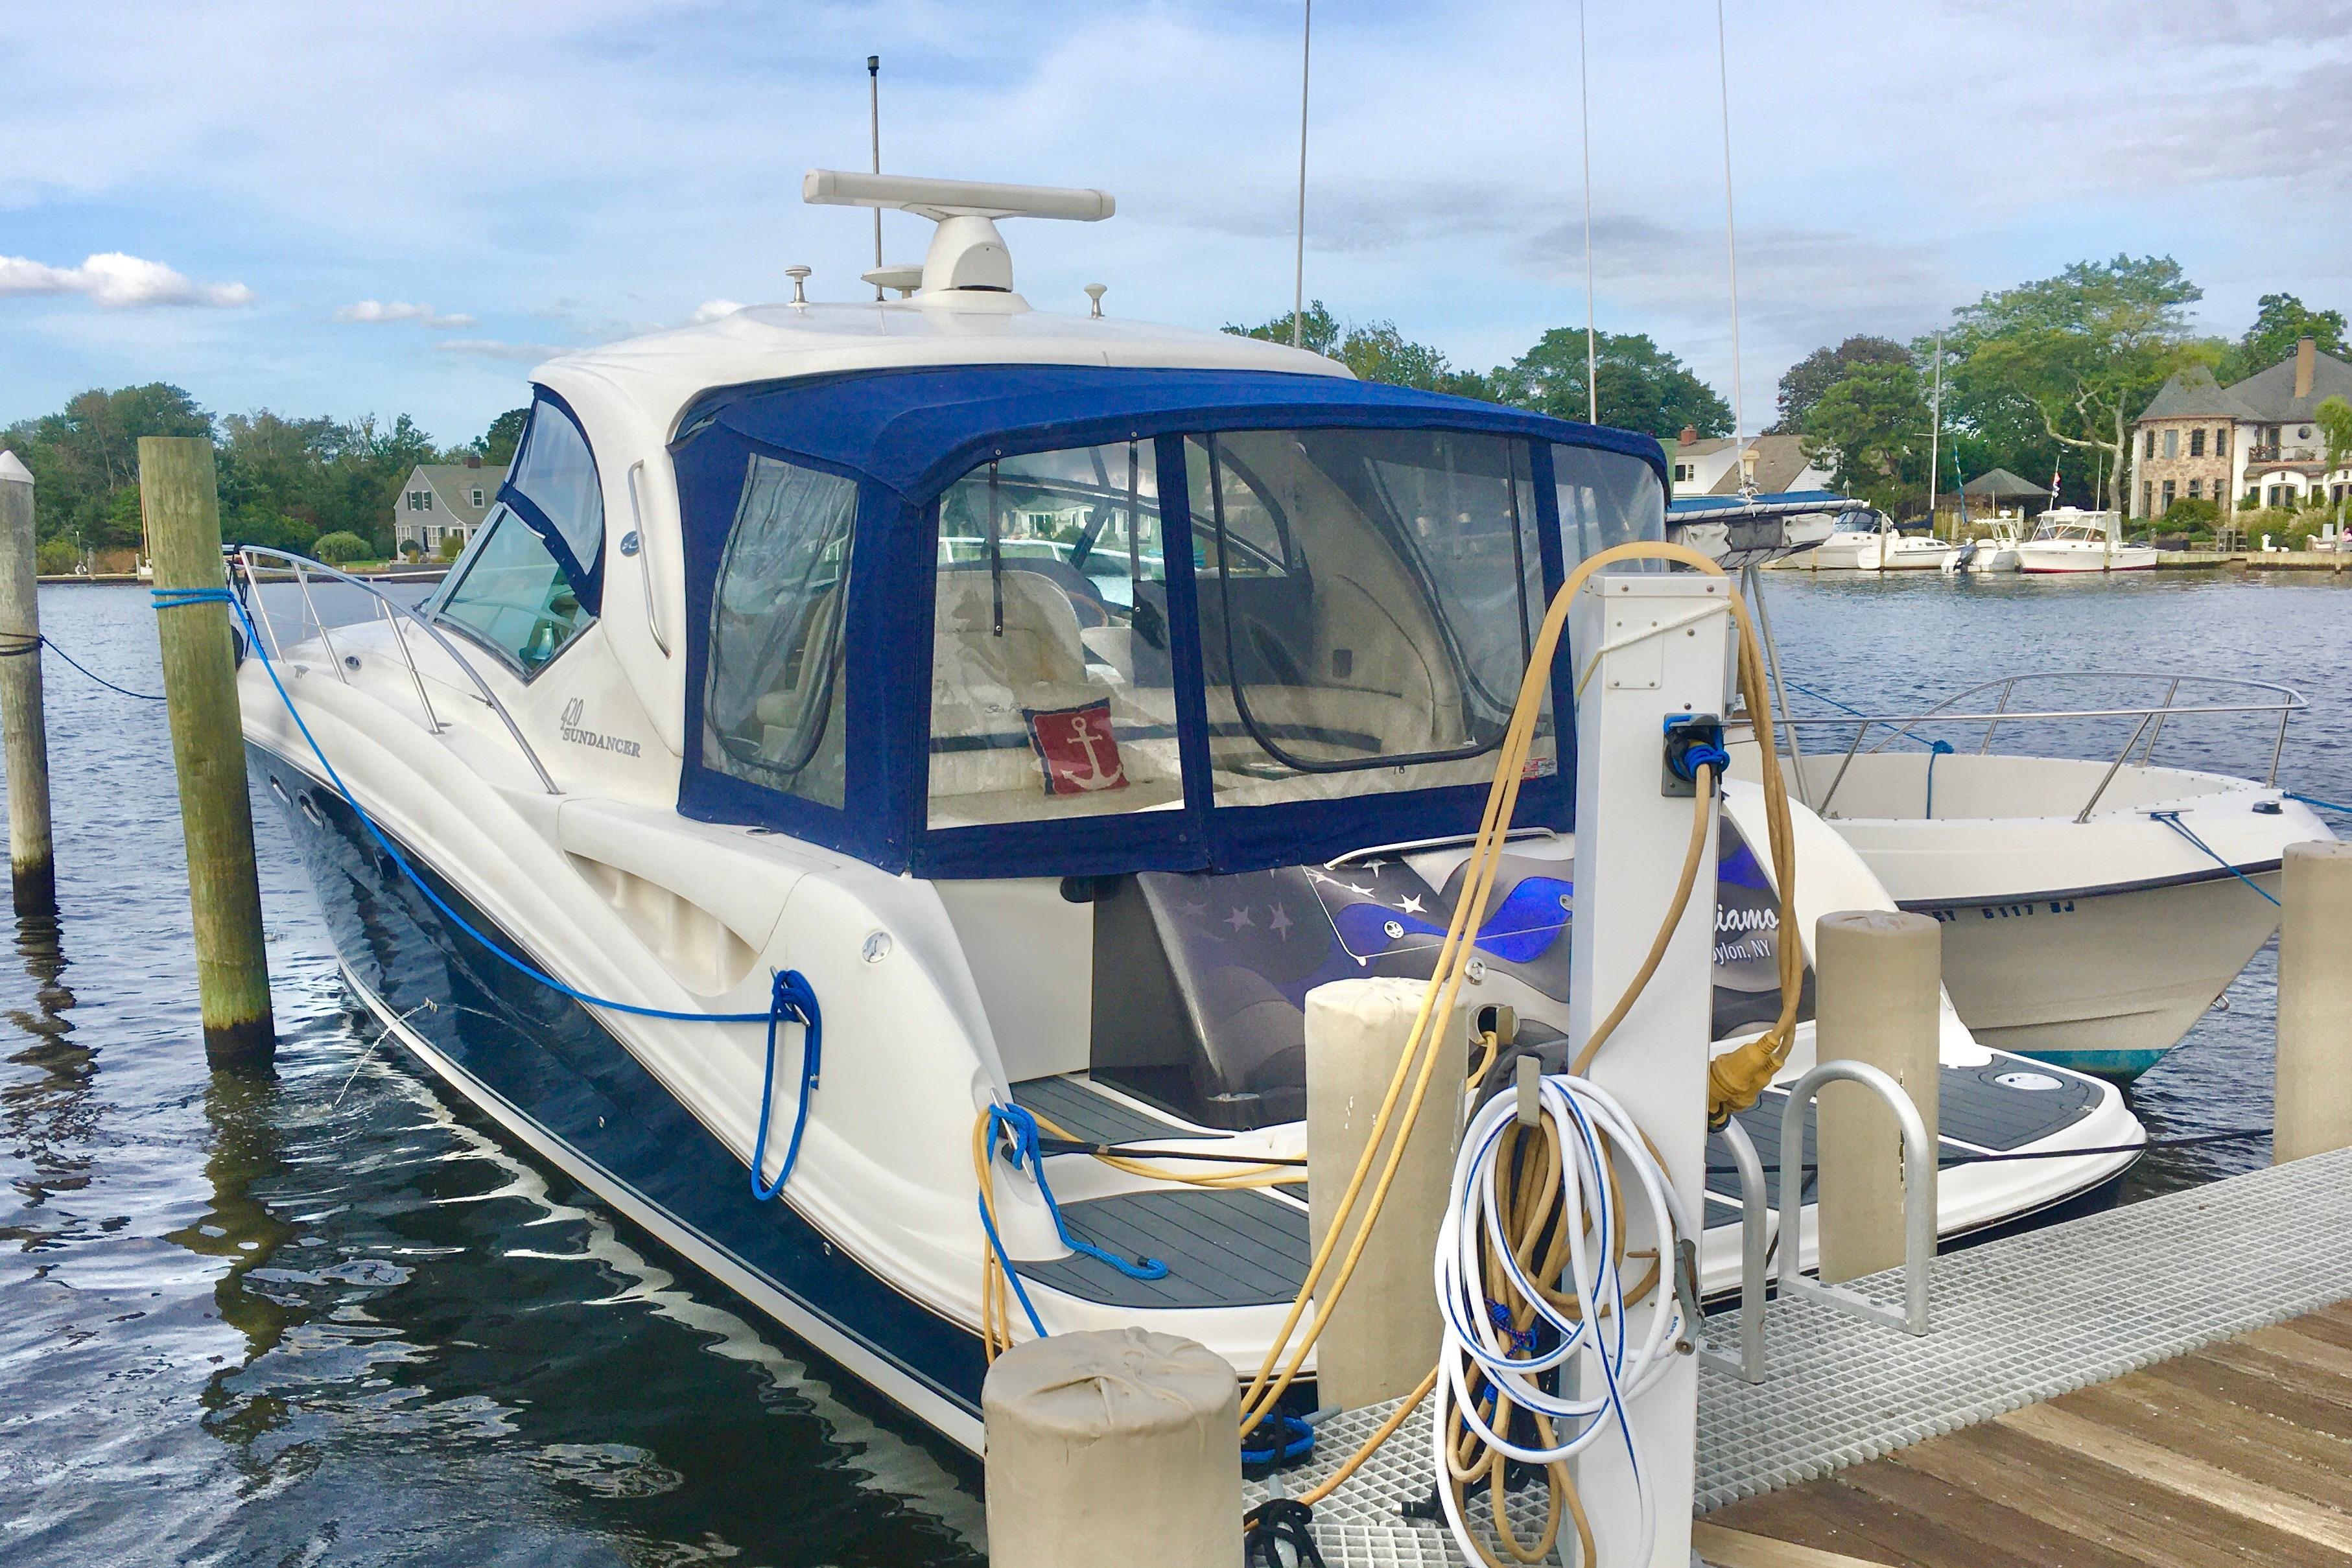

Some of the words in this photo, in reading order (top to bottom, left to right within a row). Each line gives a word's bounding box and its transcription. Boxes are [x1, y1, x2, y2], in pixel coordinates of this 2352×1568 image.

[560, 697, 584, 731] 420
[562, 727, 641, 758] SUNDANCER
[1715, 903, 1780, 931] iamo
[1750, 939, 1771, 957] NY
